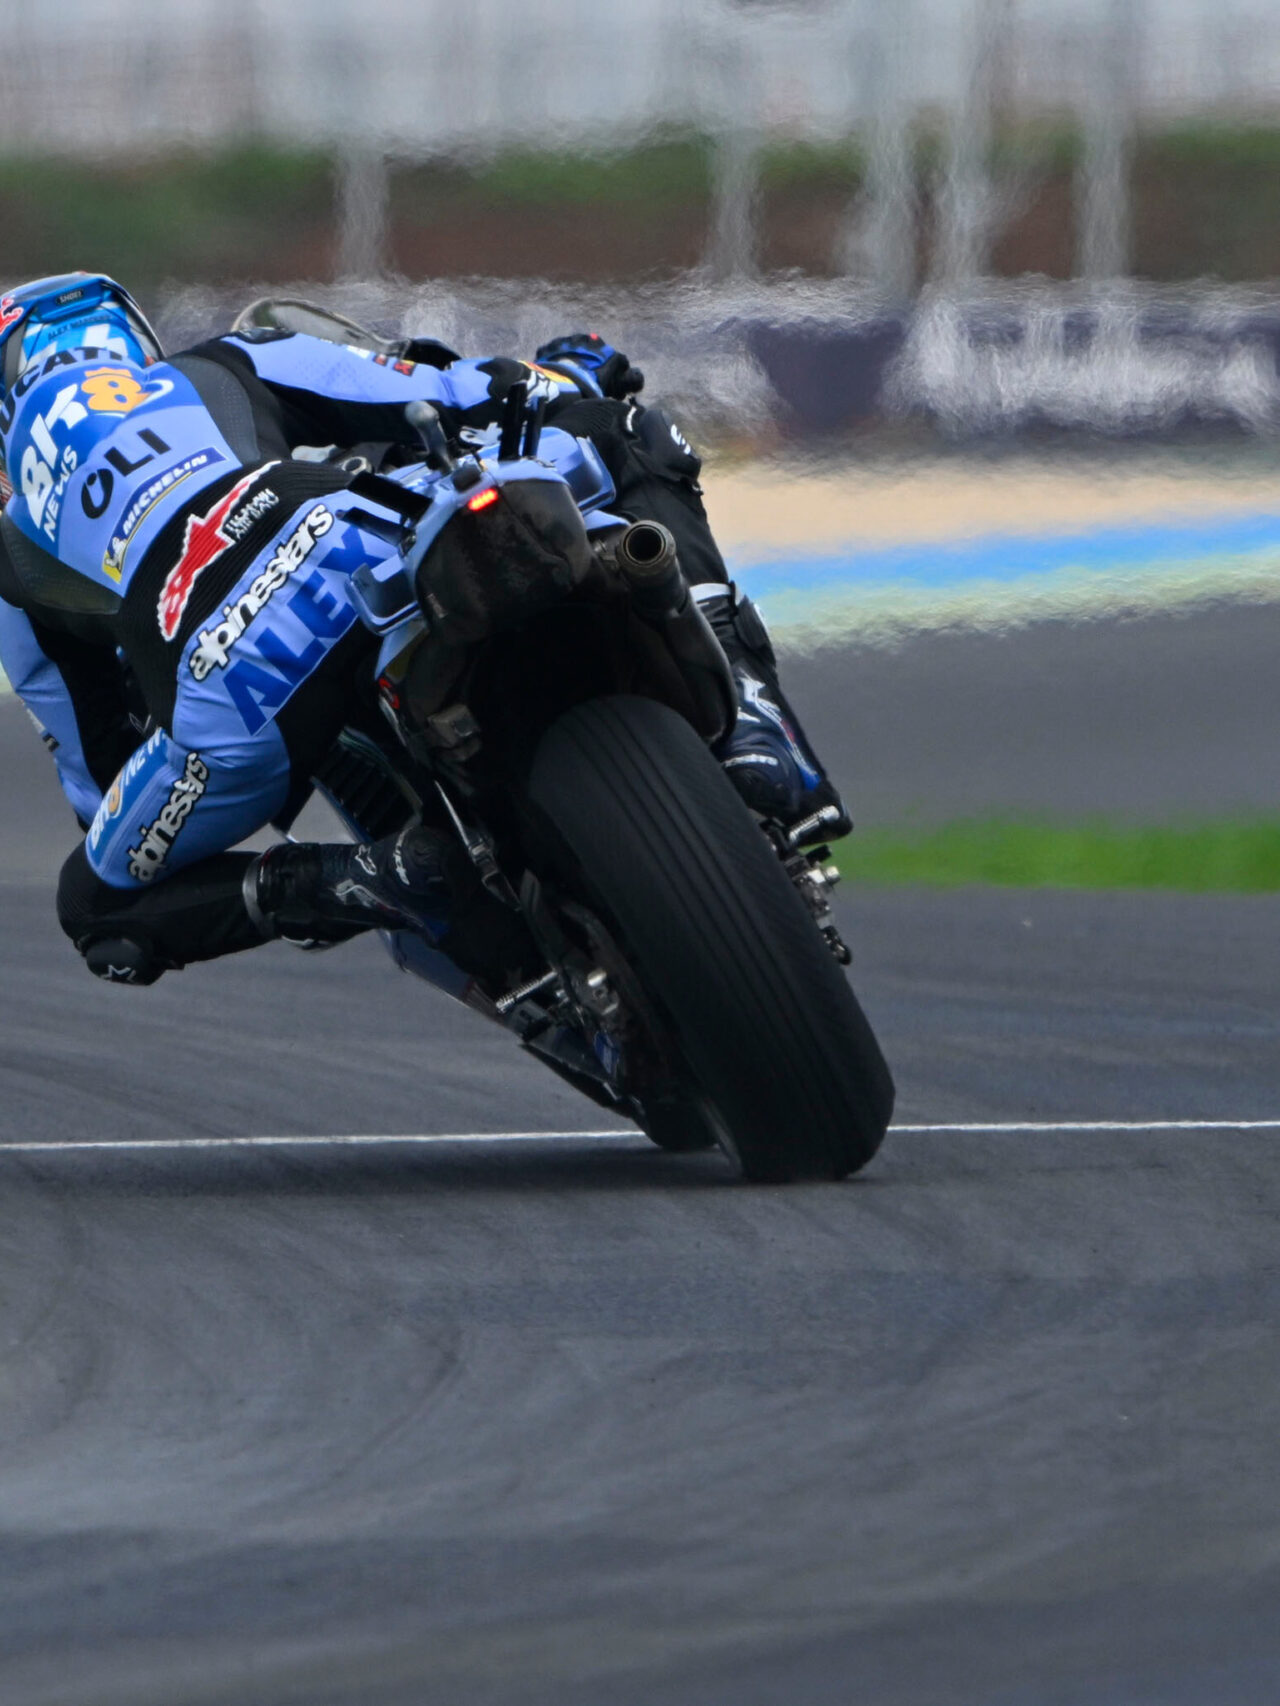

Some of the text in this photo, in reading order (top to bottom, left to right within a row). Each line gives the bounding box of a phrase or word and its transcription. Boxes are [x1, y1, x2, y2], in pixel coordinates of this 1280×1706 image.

[43, 445, 78, 543] NEWS
[122, 454, 208, 533] MICHELIN
[188, 503, 334, 682] alpinestars
[222, 525, 388, 737] ALEX
